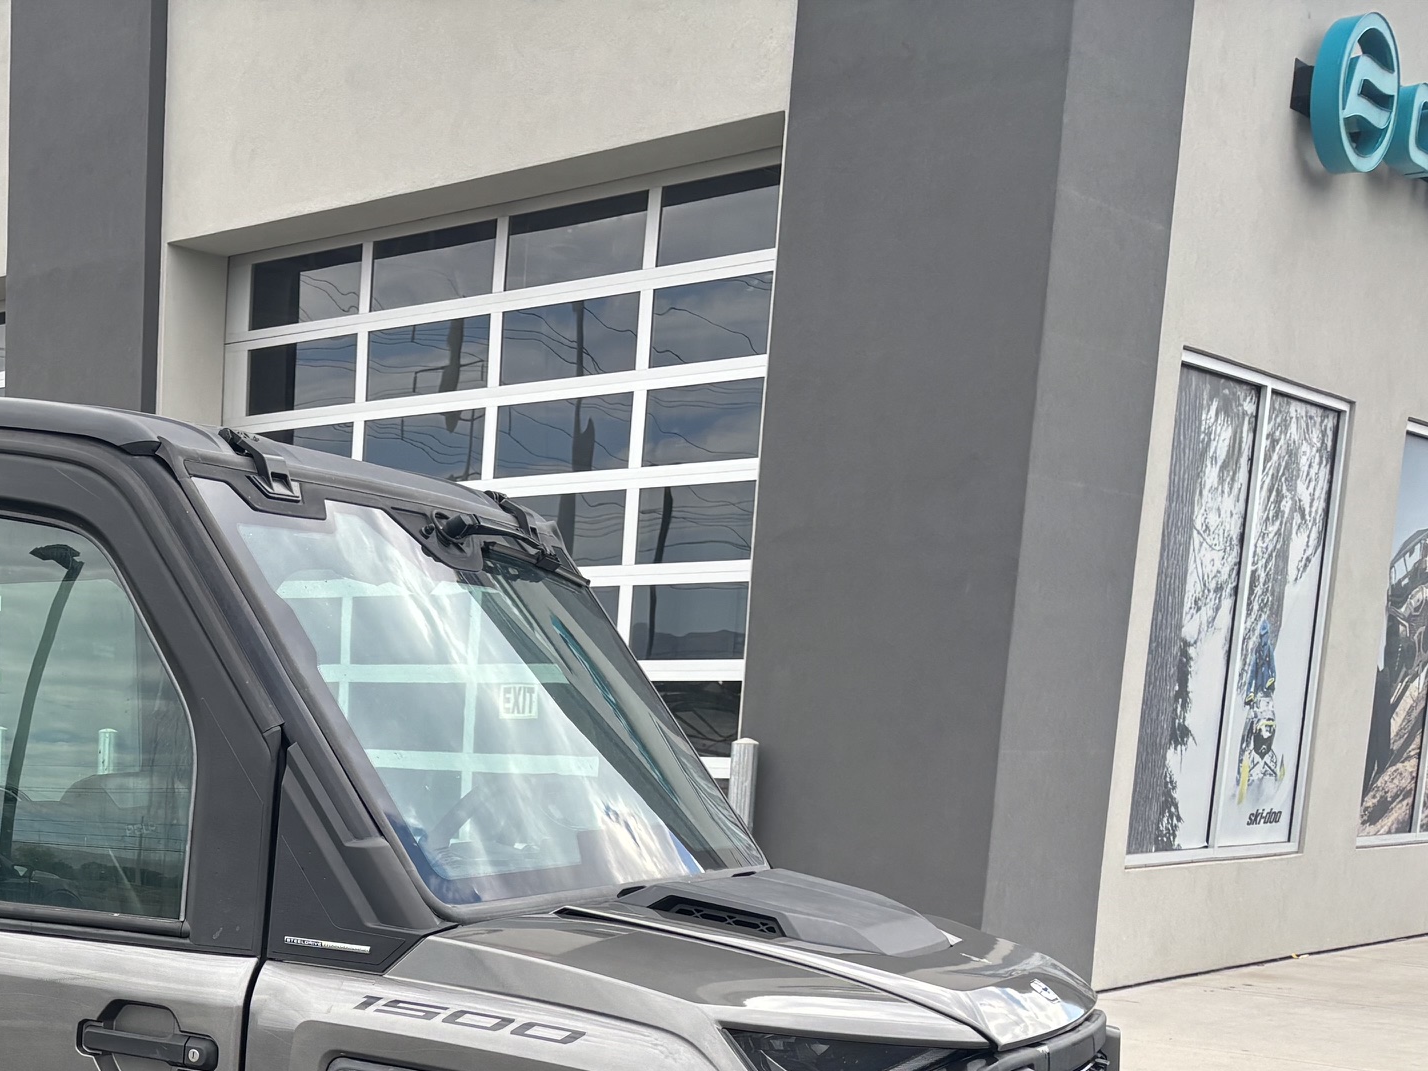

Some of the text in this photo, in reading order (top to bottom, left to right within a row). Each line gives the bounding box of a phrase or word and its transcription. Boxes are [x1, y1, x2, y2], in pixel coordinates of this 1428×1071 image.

[503, 686, 535, 715] EXIT
[1246, 808, 1283, 826] ski-doo
[352, 995, 587, 1045] 1500
